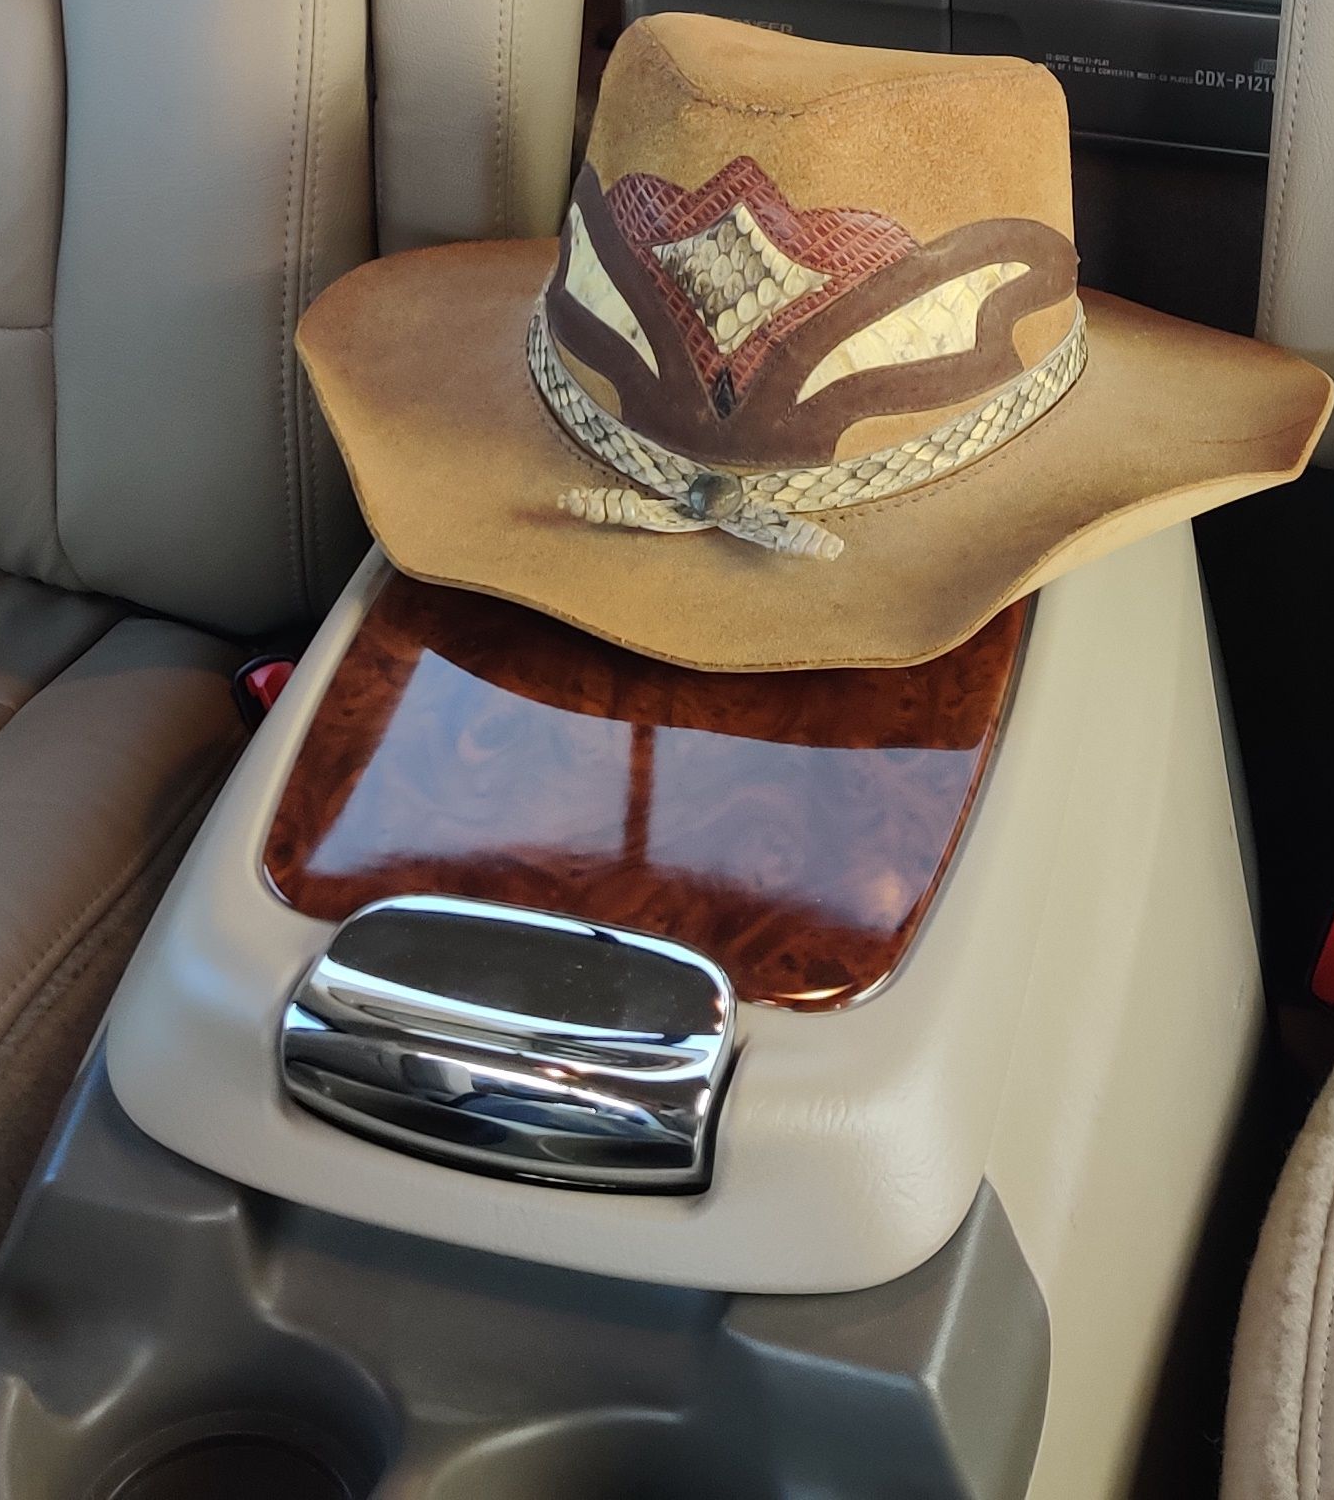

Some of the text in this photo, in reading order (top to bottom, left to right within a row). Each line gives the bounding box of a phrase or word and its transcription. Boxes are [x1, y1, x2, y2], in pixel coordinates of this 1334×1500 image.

[1072, 56, 1110, 67] MULTI-PLAY
[1098, 67, 1135, 79] CONVERTER
[1194, 69, 1275, 94] CDX-P121
